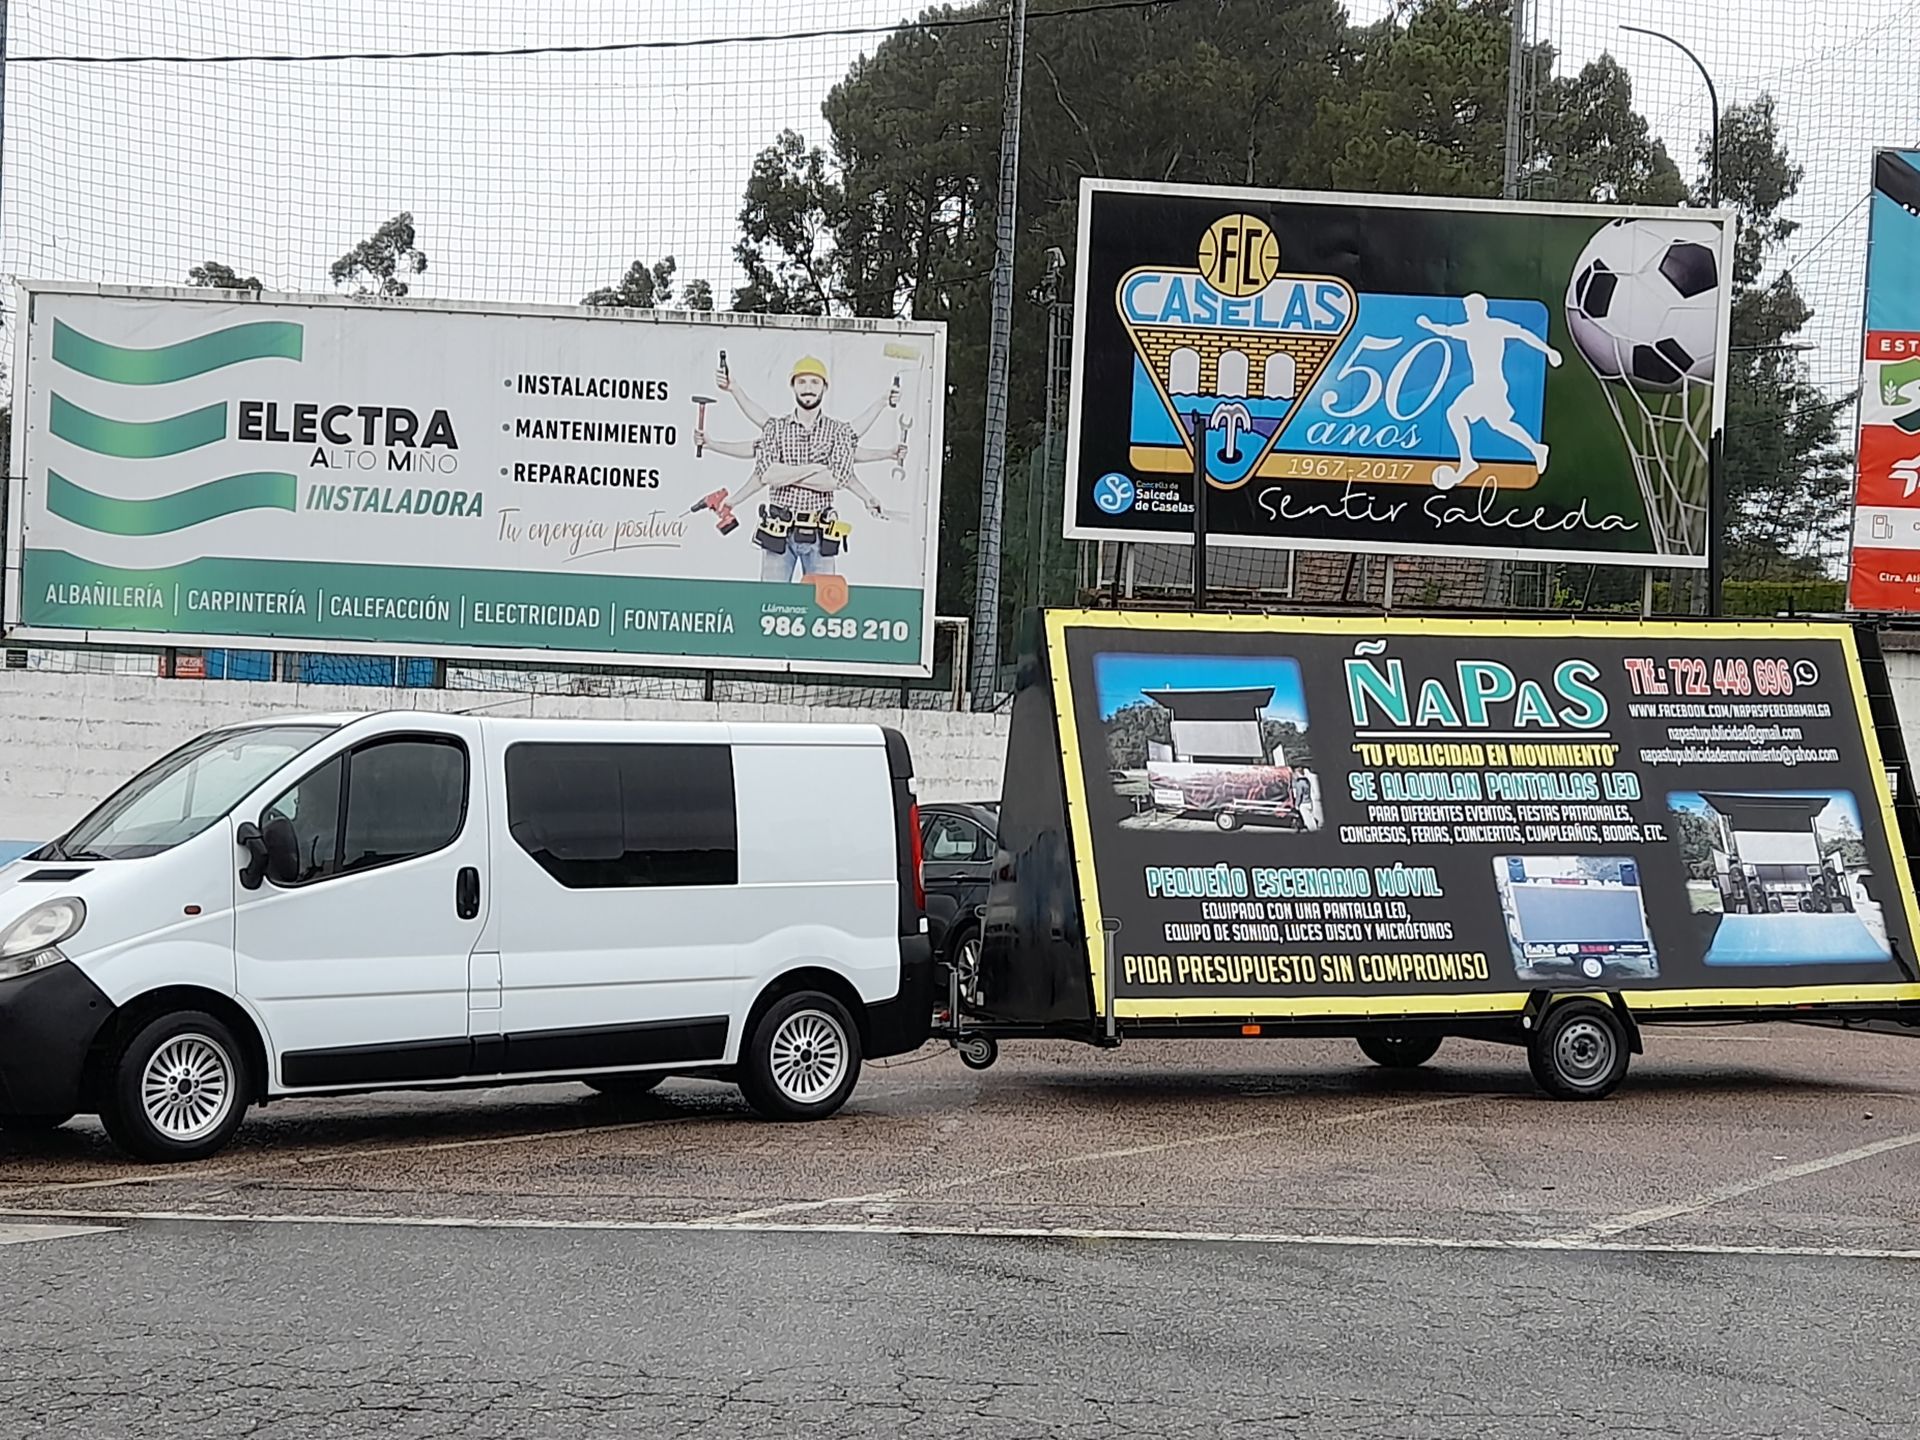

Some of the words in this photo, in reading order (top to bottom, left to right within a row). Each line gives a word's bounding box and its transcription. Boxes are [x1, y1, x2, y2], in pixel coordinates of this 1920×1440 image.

[1219, 227, 1262, 285] FC
[1126, 274, 1346, 331] CASELAS
[517, 374, 668, 402] INSTALACIONES
[1321, 335, 1452, 421] 50
[237, 400, 458, 450] ELECTRA
[515, 418, 677, 446] MANTENIMIENTO
[1306, 419, 1422, 449] anos
[310, 446, 376, 470] ALTO
[387, 447, 457, 474] MIÑO
[1287, 458, 1415, 481] 1967-2017
[513, 463, 660, 489] REPARACIONES
[305, 484, 483, 517] INSTALADORA
[1135, 501, 1149, 511] de
[1151, 502, 1195, 513] Caselas
[1136, 489, 1180, 501] Salceda
[497, 508, 526, 543] Tu
[529, 518, 609, 555] energía
[612, 510, 688, 551] positiva
[1879, 572, 1903, 582] Ctra.
[44, 580, 164, 608] ALBAÑILERÍA
[188, 588, 306, 615] CARPINTERÍA
[330, 595, 450, 621] CALEFACCIÓN
[473, 601, 600, 627] ELECTRICIDAD
[624, 607, 734, 634] FONTANERÍA
[761, 615, 806, 637] 986
[812, 617, 857, 639] 658
[862, 620, 909, 641] 210
[1668, 658, 1711, 695] 722
[1713, 658, 1751, 695] 448
[1752, 658, 1794, 695] 696
[1668, 724, 1802, 745] napastupublicidad@gmail.com
[1384, 744, 1485, 766] PUBLICIDAD
[1488, 745, 1508, 766] EN
[1640, 745, 1839, 766] napastupublicidadenmovimiento@yahoo.com
[1349, 772, 1377, 800] SE
[1380, 772, 1482, 801] ALQUILAN
[1486, 772, 1600, 801] PANTALLAS
[1601, 773, 1641, 801] LED
[1369, 805, 1399, 822] PARA
[1401, 805, 1464, 822] DIFERENTES
[1465, 805, 1517, 823] EVENTOS,
[1518, 805, 1560, 822] FIESTAS
[1562, 805, 1633, 823] PATRONALES,
[1340, 826, 1411, 845] CONGRESOS,
[1412, 826, 1453, 844] FERIAS,
[1454, 825, 1525, 844] CONCIERTOS,
[1526, 823, 1602, 844] CUMPLEAÑOS,
[1604, 825, 1643, 843] BODAS,
[1644, 825, 1667, 841] ETC.
[1145, 863, 1248, 898] PEQUEÑO
[1252, 868, 1371, 898] ESCENARIO
[1375, 862, 1443, 897] MÓVIL
[1202, 902, 1265, 920] EQUIPADO
[1267, 902, 1293, 920] CON
[1295, 902, 1321, 920] UNA
[1323, 902, 1383, 919] PANTALLA
[1385, 901, 1411, 921] LED,
[1165, 924, 1211, 941] EQUIPO
[1213, 924, 1230, 941] DE
[1232, 924, 1284, 944] SONIDO,
[1285, 923, 1323, 941] LUCES
[1326, 923, 1362, 940] DISCO
[1363, 923, 1373, 940] Y
[1375, 919, 1453, 940] MICRÓFONOS
[1123, 955, 1173, 984] PIDA
[1177, 954, 1316, 984] PRESUPUESTO
[1320, 954, 1354, 982] SIN
[1358, 952, 1489, 982] COMPROMISO
